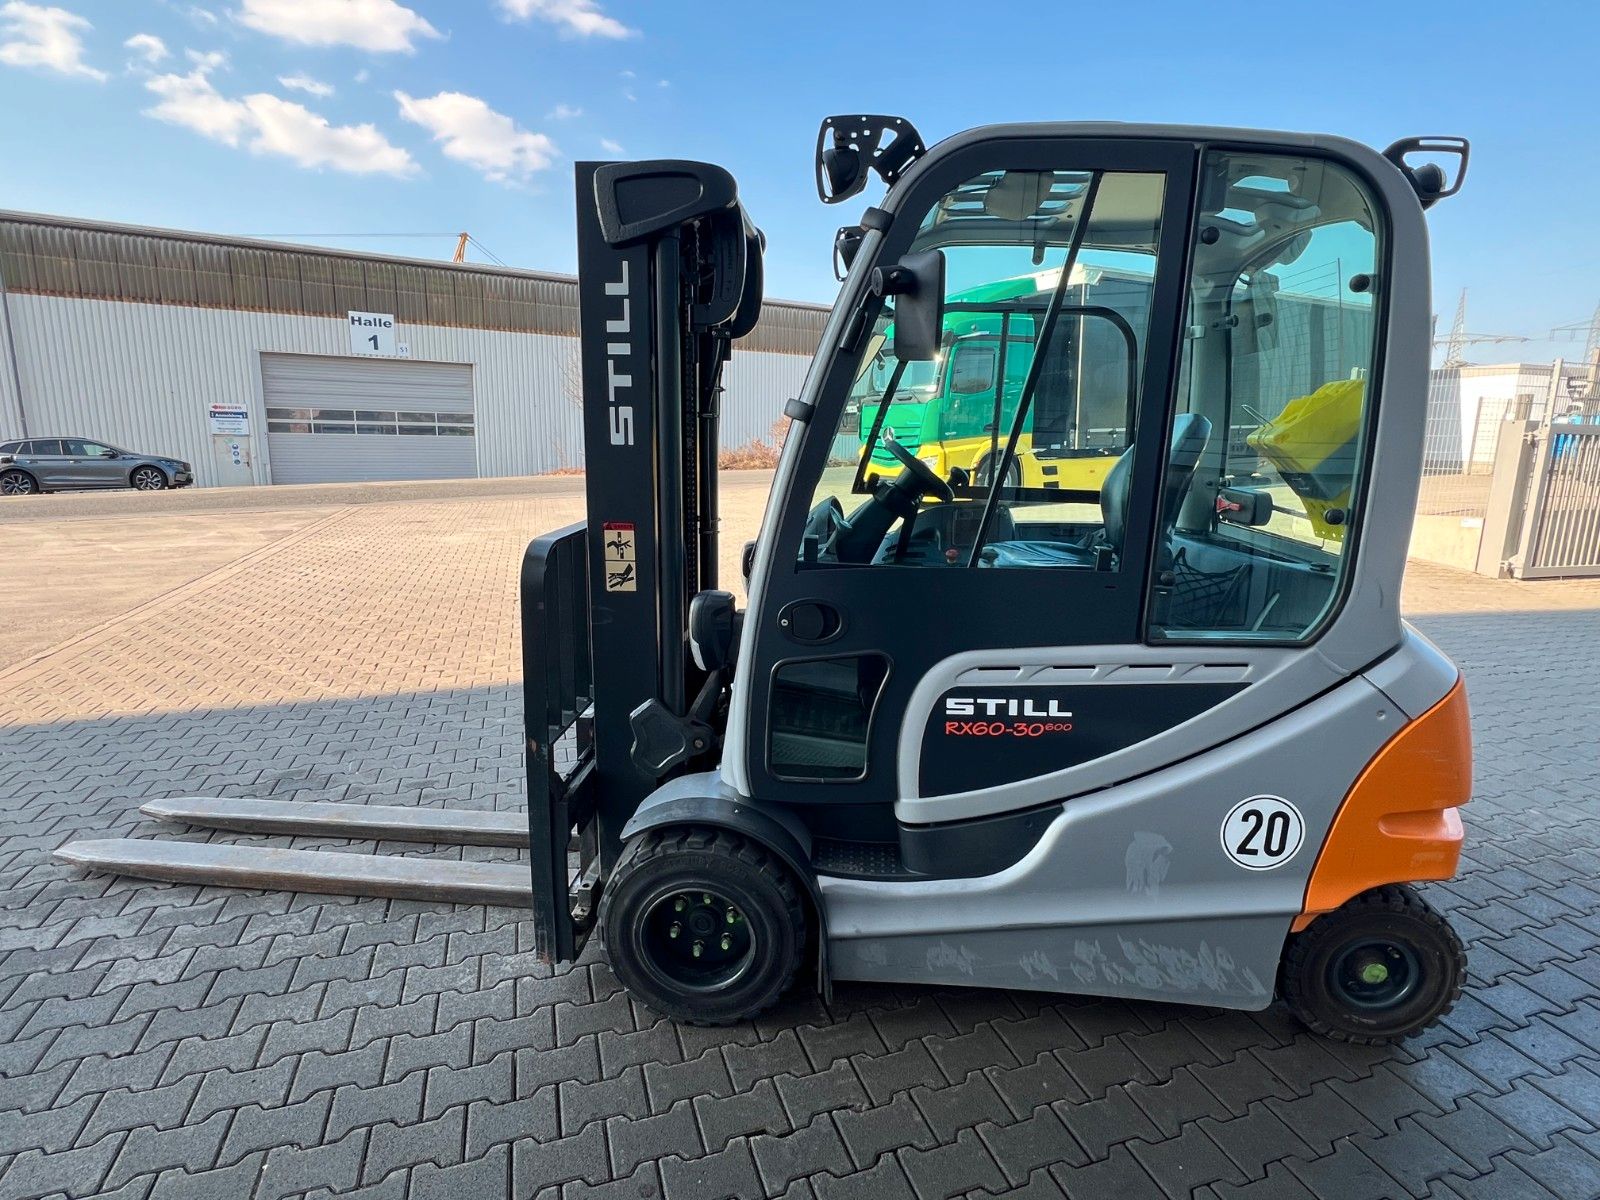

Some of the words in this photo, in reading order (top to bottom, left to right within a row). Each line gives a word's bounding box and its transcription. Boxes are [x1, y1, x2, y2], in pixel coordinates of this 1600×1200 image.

[350, 316, 392, 328] Halle
[368, 334, 379, 351] 1
[605, 260, 634, 446] STILL
[945, 698, 1073, 717] STILL
[1236, 809, 1291, 857] 20
